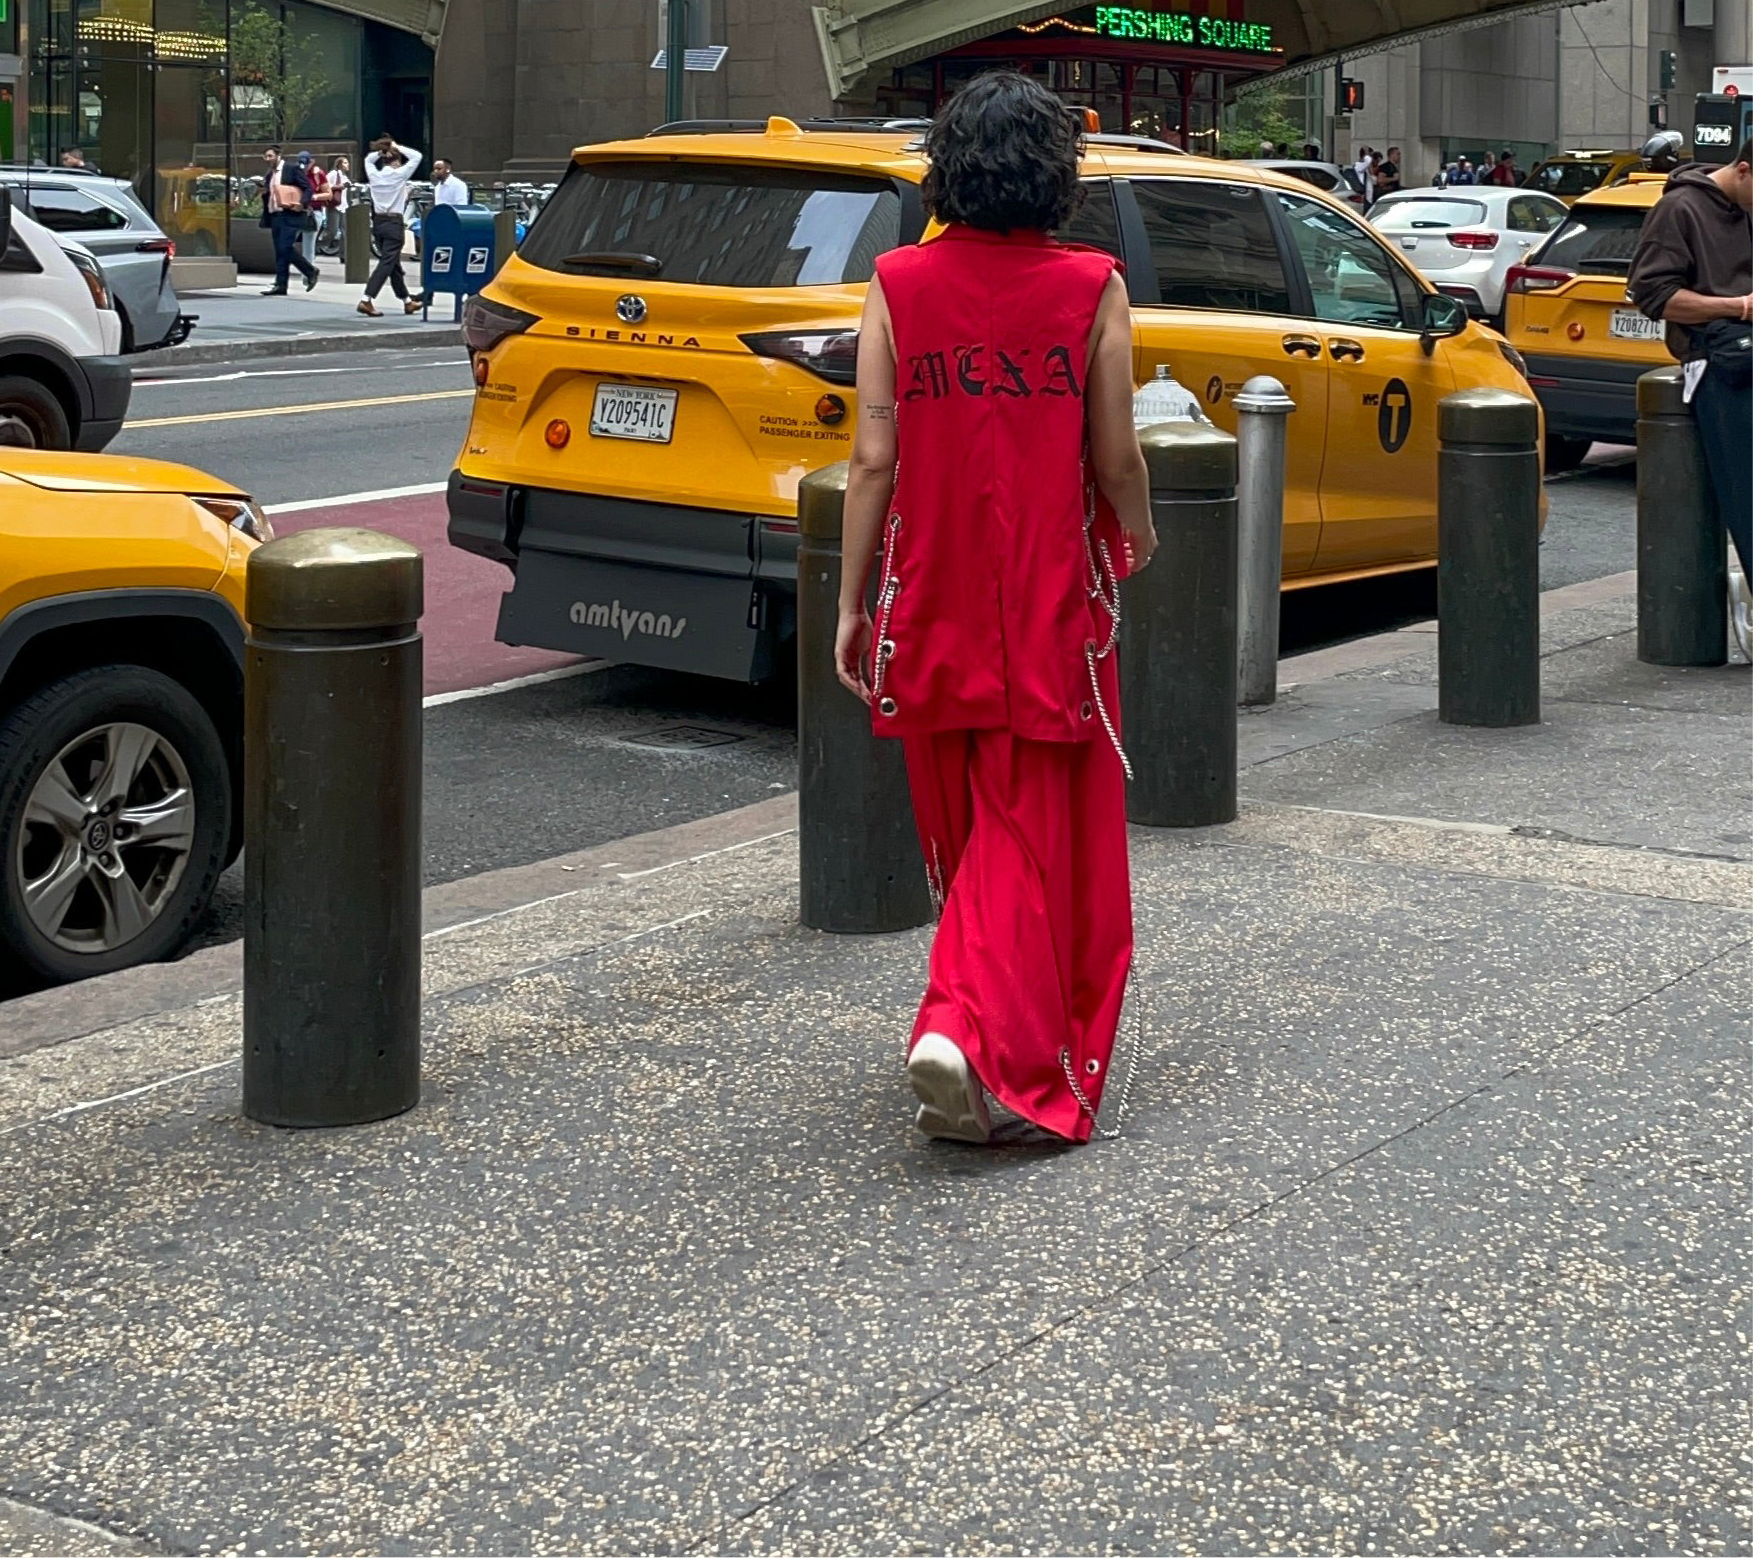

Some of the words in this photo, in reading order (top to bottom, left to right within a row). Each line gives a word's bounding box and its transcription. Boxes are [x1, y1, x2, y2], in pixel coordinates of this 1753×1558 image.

[1096, 6, 1193, 43] PERSHING
[1199, 16, 1272, 51] SQUARE
[566, 326, 700, 347] SIENNA
[903, 345, 1082, 400] MEXA
[1362, 393, 1379, 406] NYC
[600, 397, 667, 428] Y209541C
[760, 415, 798, 427] CAUTION
[759, 426, 812, 439] PASSENGER
[814, 430, 850, 441] EXITING
